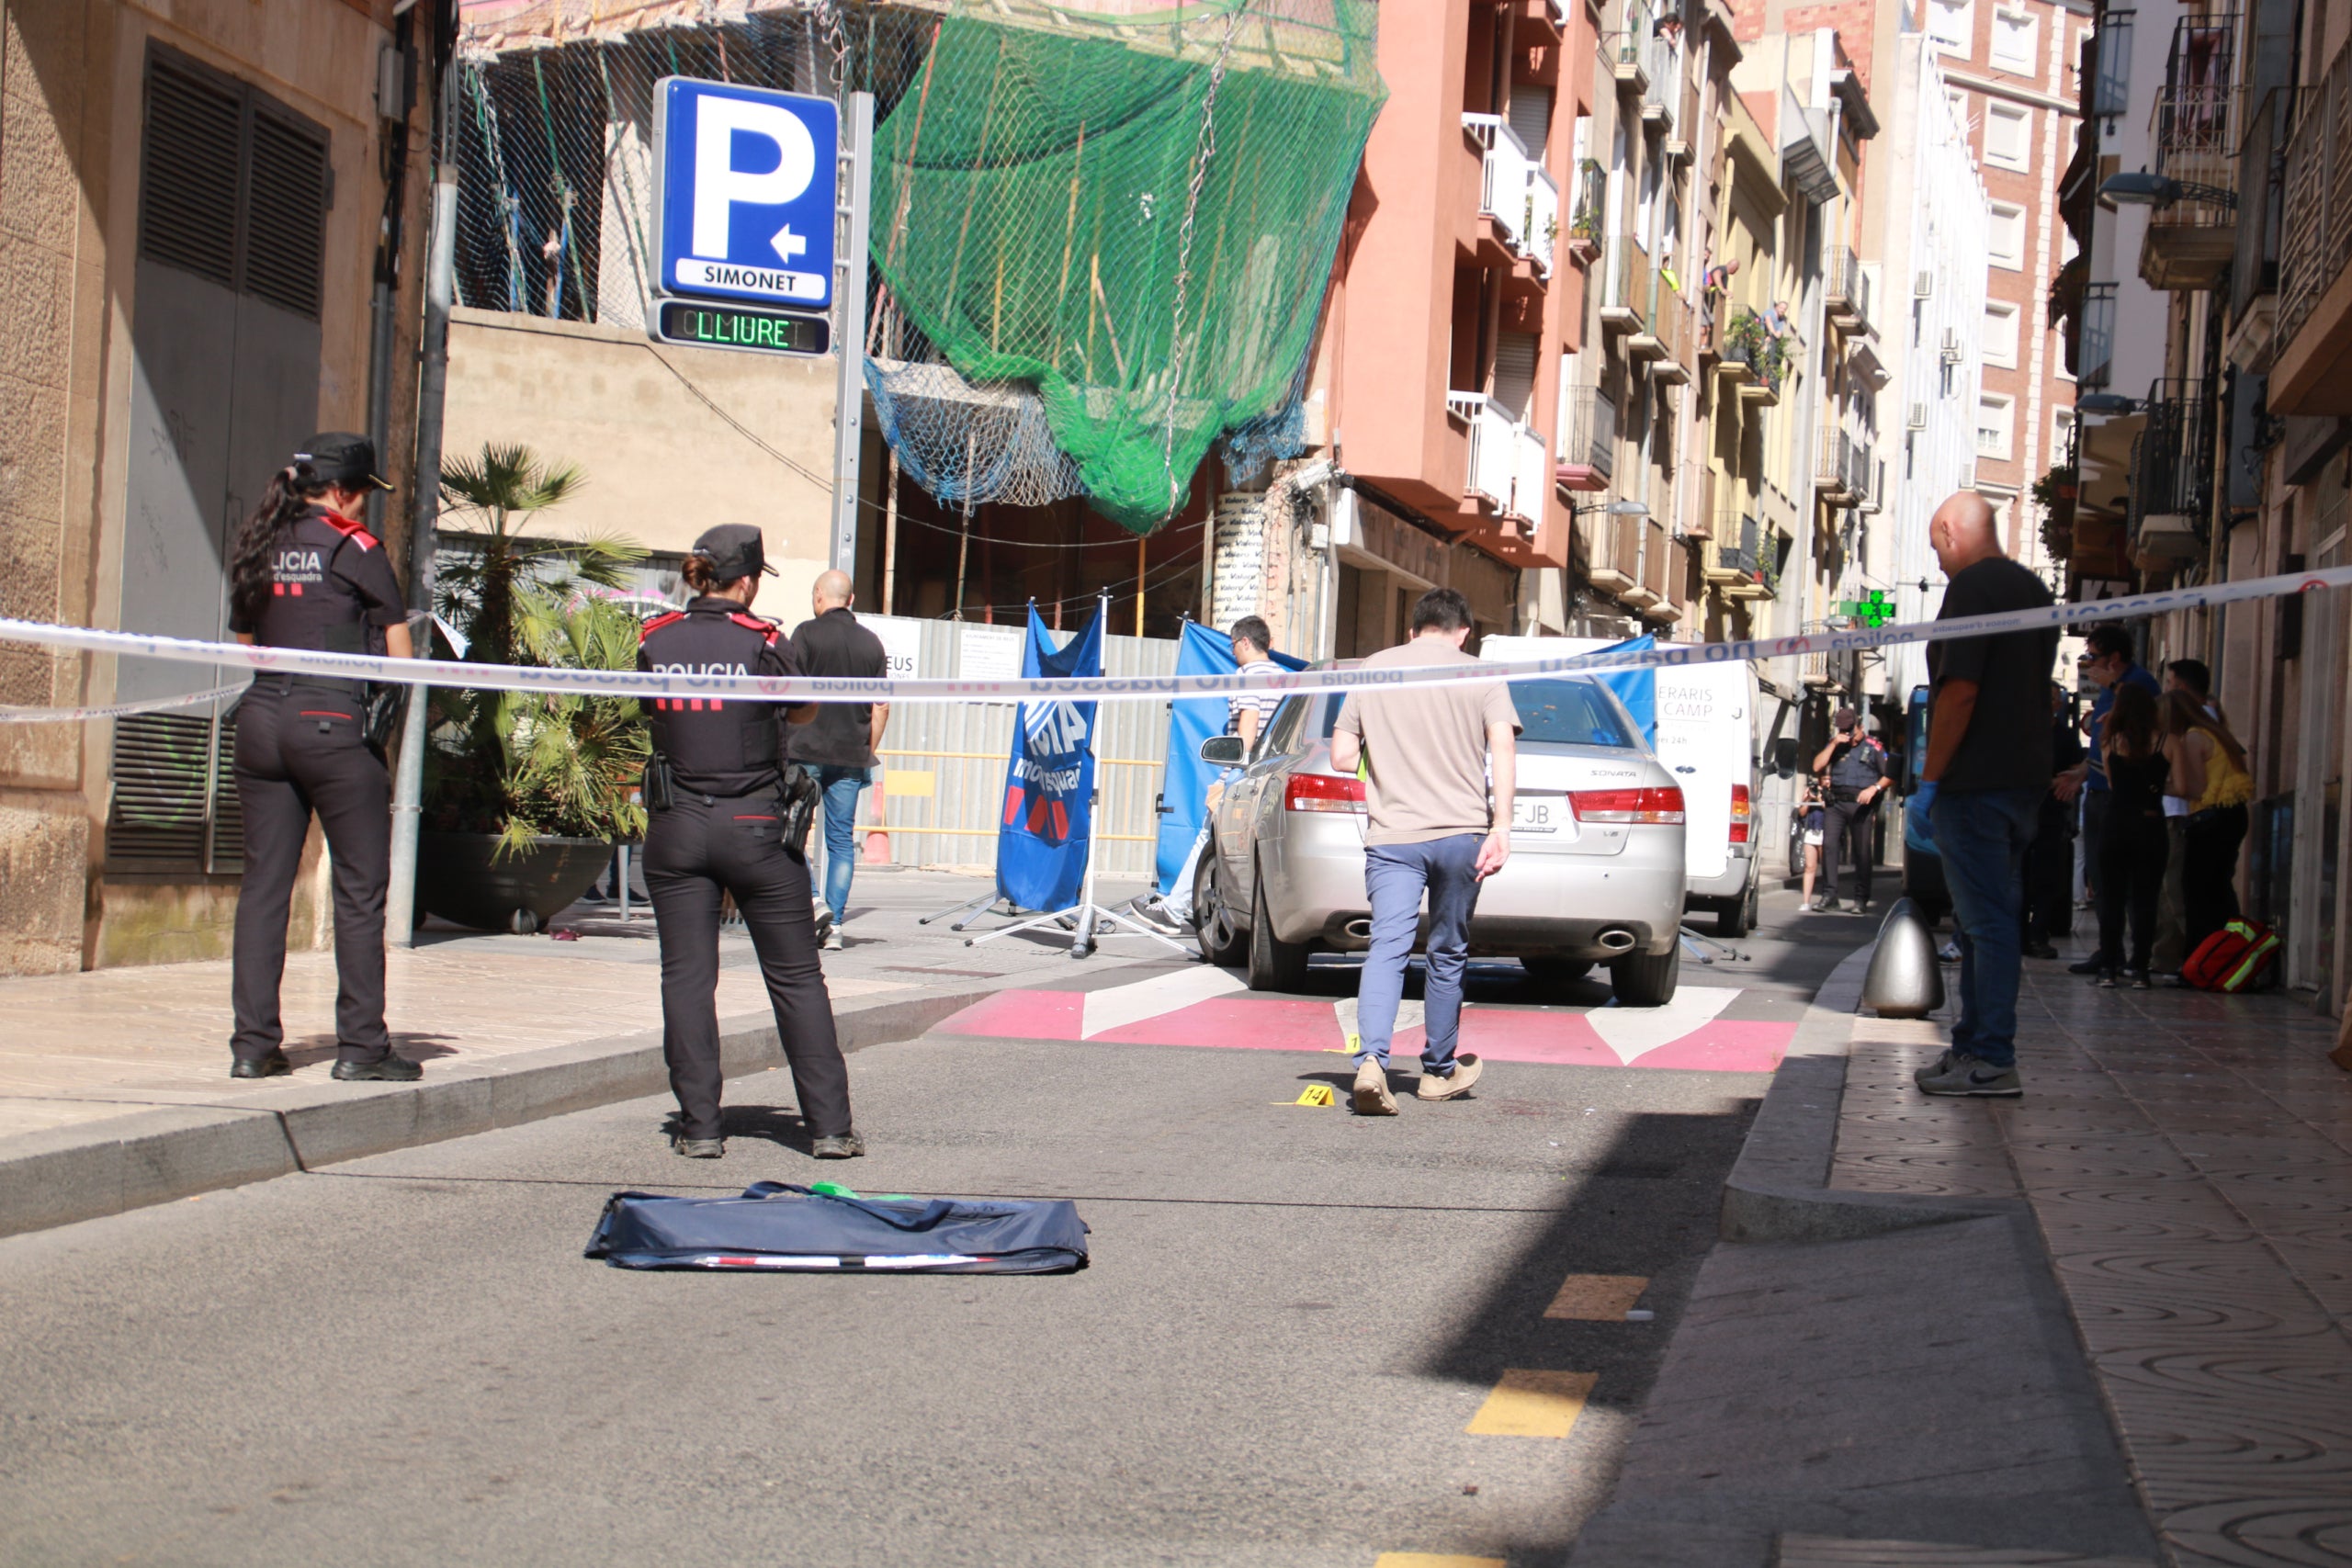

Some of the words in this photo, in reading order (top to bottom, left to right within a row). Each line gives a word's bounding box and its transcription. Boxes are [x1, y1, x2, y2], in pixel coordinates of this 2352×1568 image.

[692, 94, 816, 260] P
[704, 265, 797, 292] SIMONET
[697, 310, 789, 347] LLIURE
[1664, 704, 1713, 717] CAMP
[1306, 1088, 1323, 1101] 14
